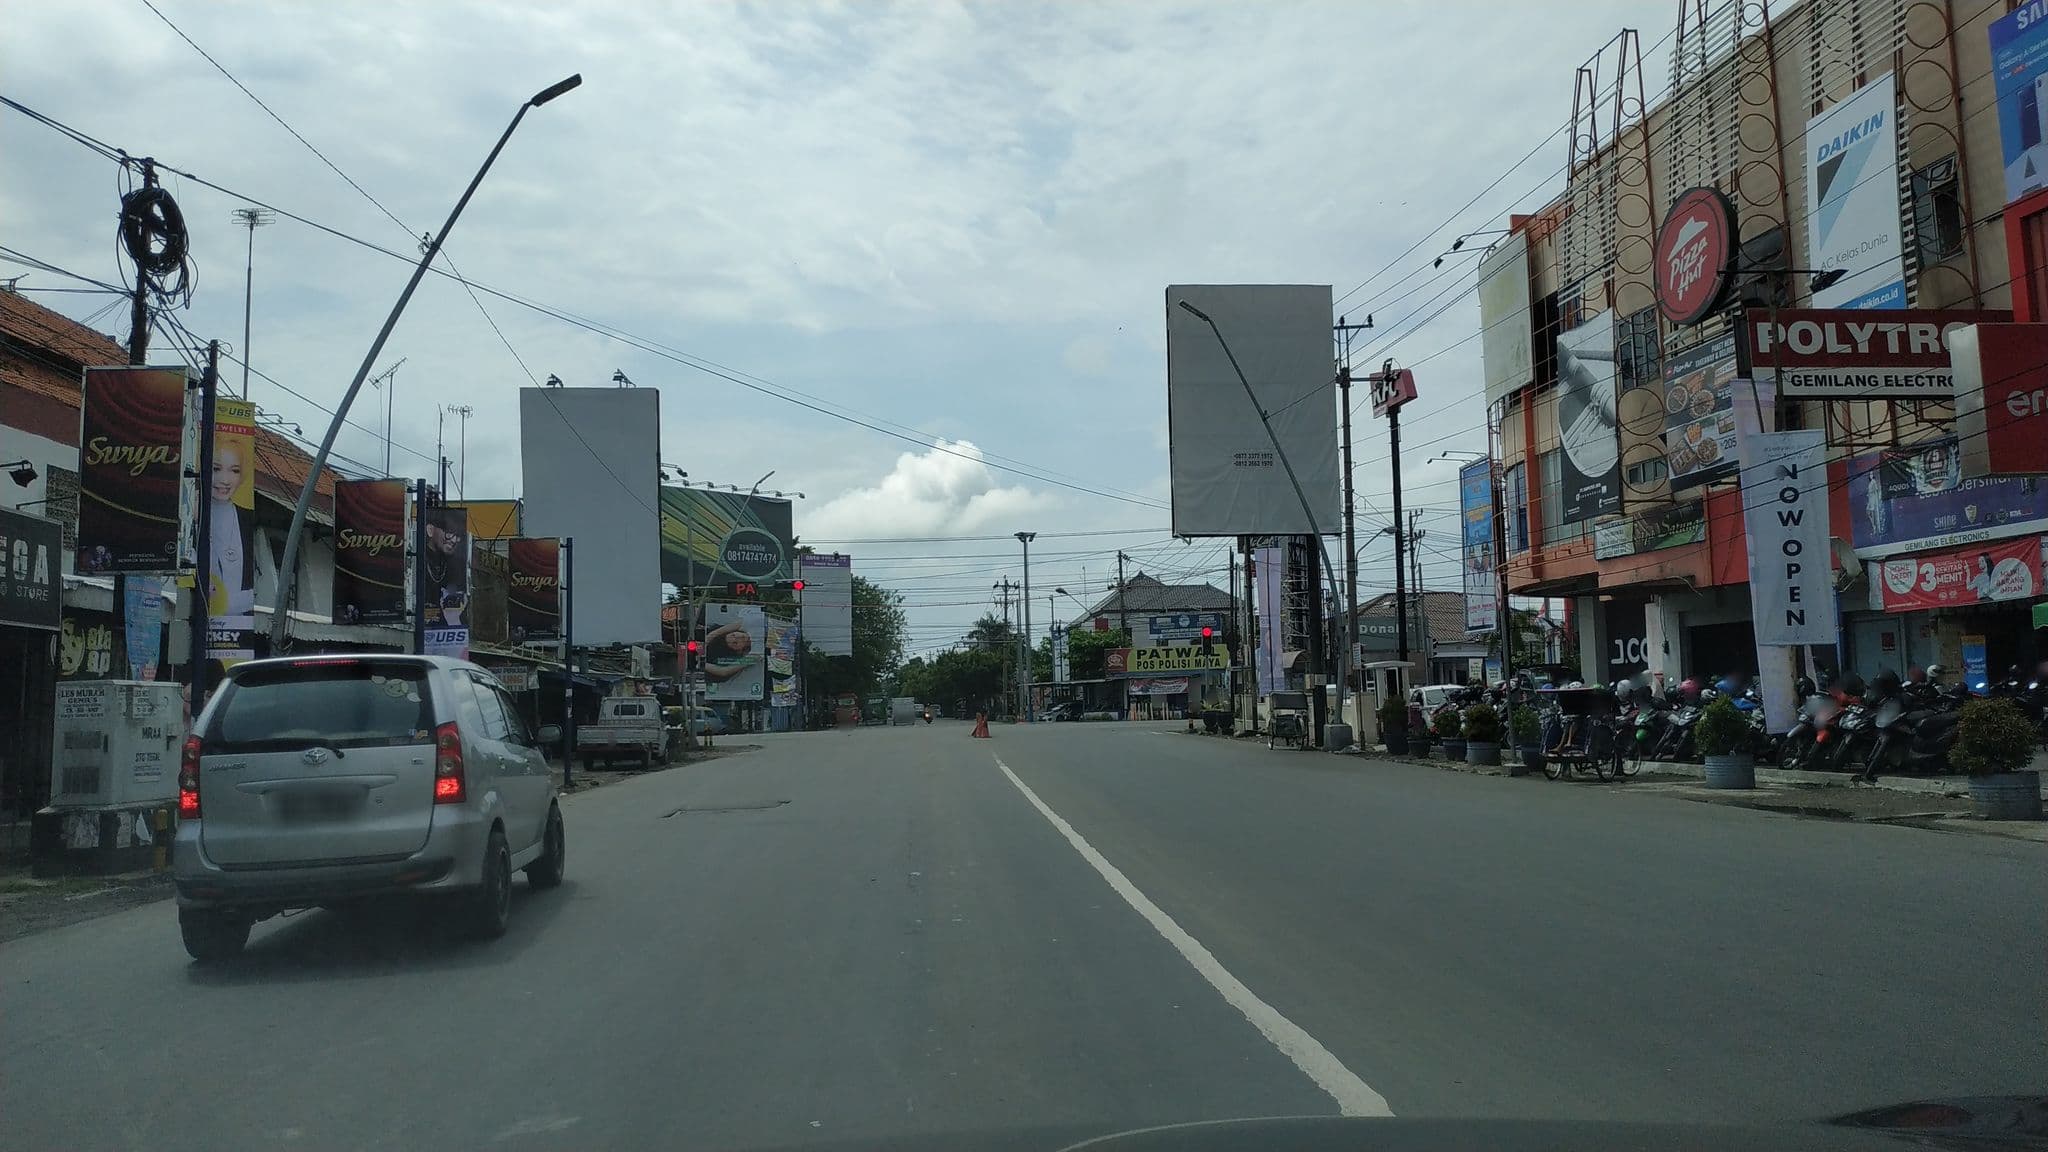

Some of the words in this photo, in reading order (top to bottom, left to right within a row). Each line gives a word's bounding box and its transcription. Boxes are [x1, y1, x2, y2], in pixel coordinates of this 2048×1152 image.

[1817, 110, 1884, 162] DAIKIN
[1820, 255, 1834, 271] AC
[1835, 244, 1859, 265] Kelas
[1861, 233, 1888, 253] Dunia
[1671, 236, 1709, 291] Pizza
[1677, 254, 1708, 302] Hut
[1790, 374, 1880, 388] GEMILANG
[229, 407, 252, 417] UBS
[2006, 390, 2048, 418] er
[215, 423, 248, 433] EWELRY
[85, 435, 181, 477] Surya
[1775, 463, 1804, 527] NOW
[338, 528, 404, 557] Surya
[738, 543, 766, 552] available
[1904, 539, 1940, 551] GEMILANG
[1940, 530, 1990, 546] ELECTRONICS
[727, 550, 778, 564] 08174747474
[511, 571, 558, 592] Surya
[1782, 538, 1805, 626] OPEN
[1920, 562, 1938, 593] 3
[1937, 570, 1964, 588] MENIT
[15, 585, 49, 602] STORE
[736, 583, 756, 595] PA
[436, 631, 466, 642] UBS
[1345, 623, 1416, 635] Donal'
[1137, 644, 1220, 660] PATWAL
[1137, 660, 1155, 670] POS
[1158, 659, 1190, 669] POLISI
[1194, 658, 1220, 668] MAYA
[61, 689, 75, 698] LES
[75, 688, 105, 698] MURAH
